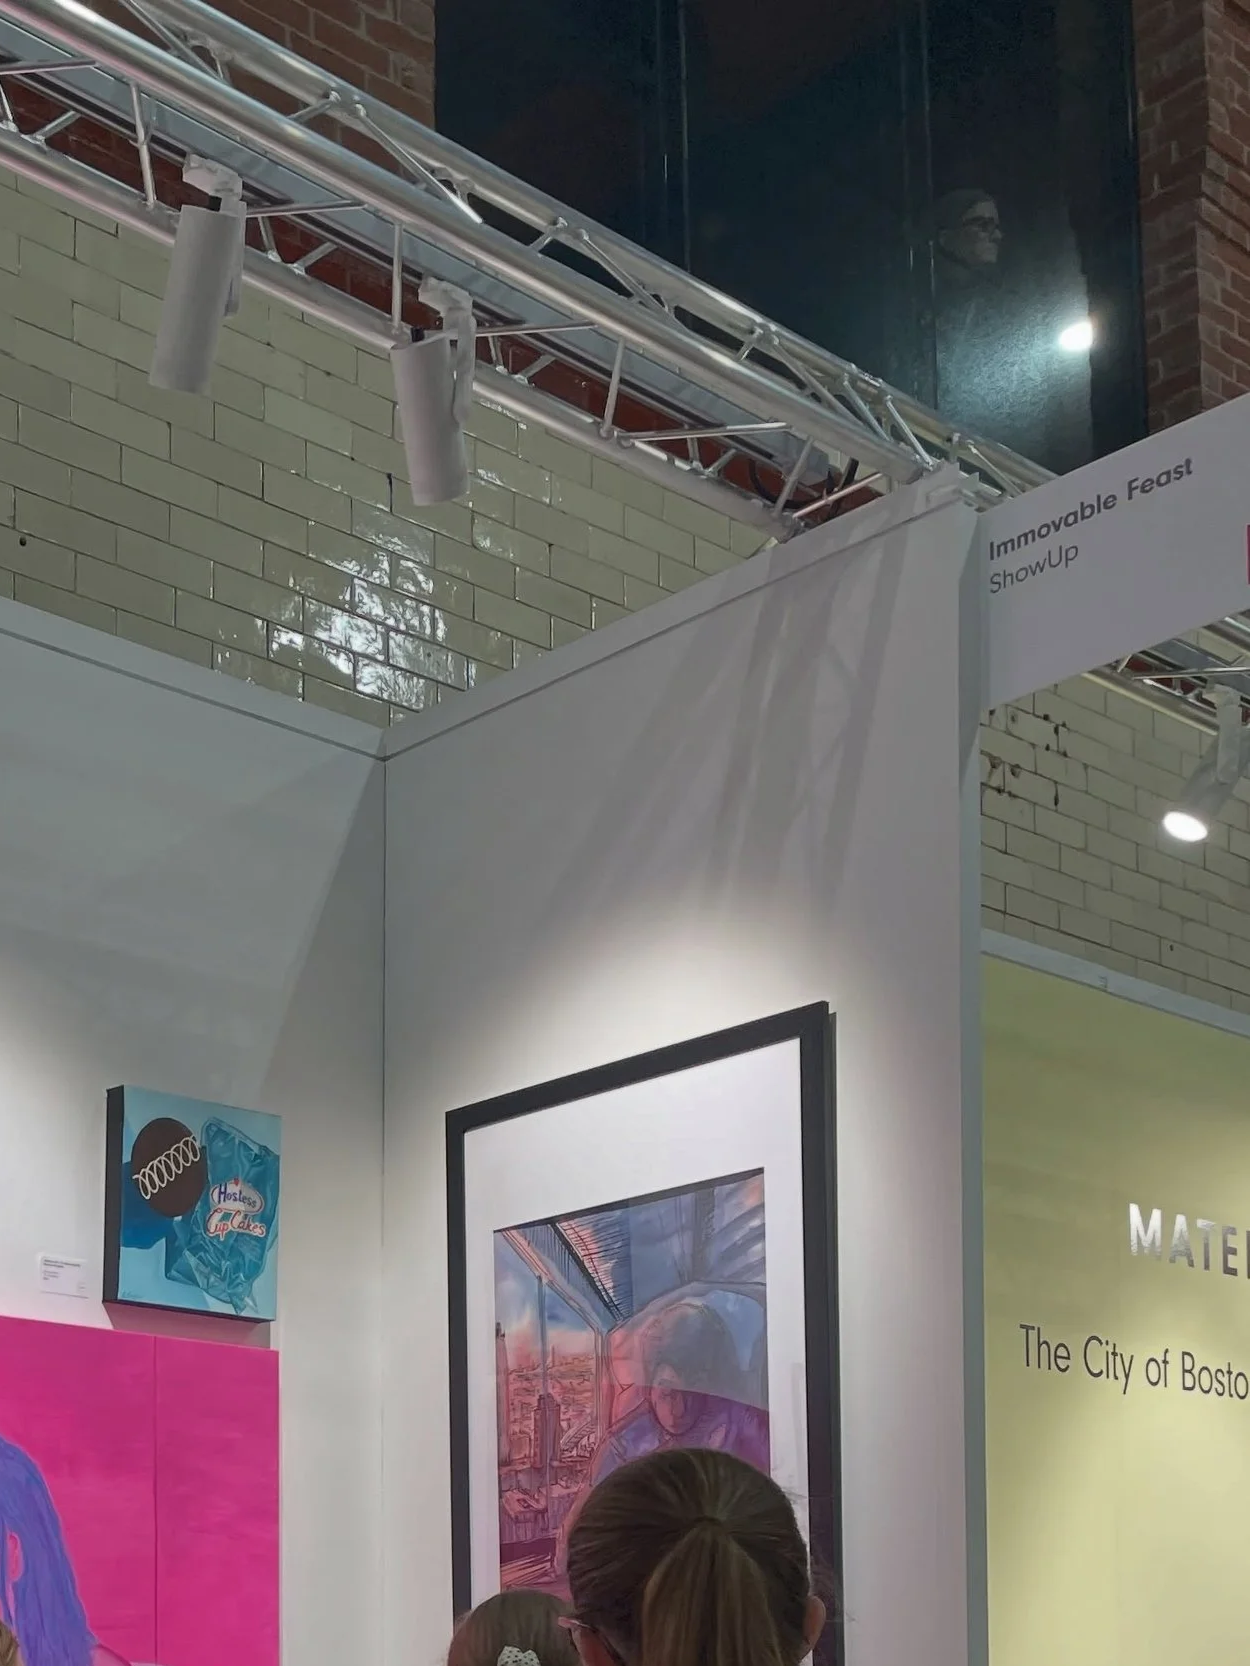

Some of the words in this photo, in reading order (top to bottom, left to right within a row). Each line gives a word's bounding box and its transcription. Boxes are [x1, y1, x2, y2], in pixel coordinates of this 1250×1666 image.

[989, 494, 1118, 561] Immovable
[1127, 457, 1193, 501] Feast
[989, 544, 1079, 594] ShowUp
[1129, 1202, 1250, 1280] MATE
[1019, 1324, 1071, 1373] The
[1084, 1335, 1134, 1395] City
[1146, 1348, 1169, 1388] of
[1182, 1351, 1249, 1400] Bosto
